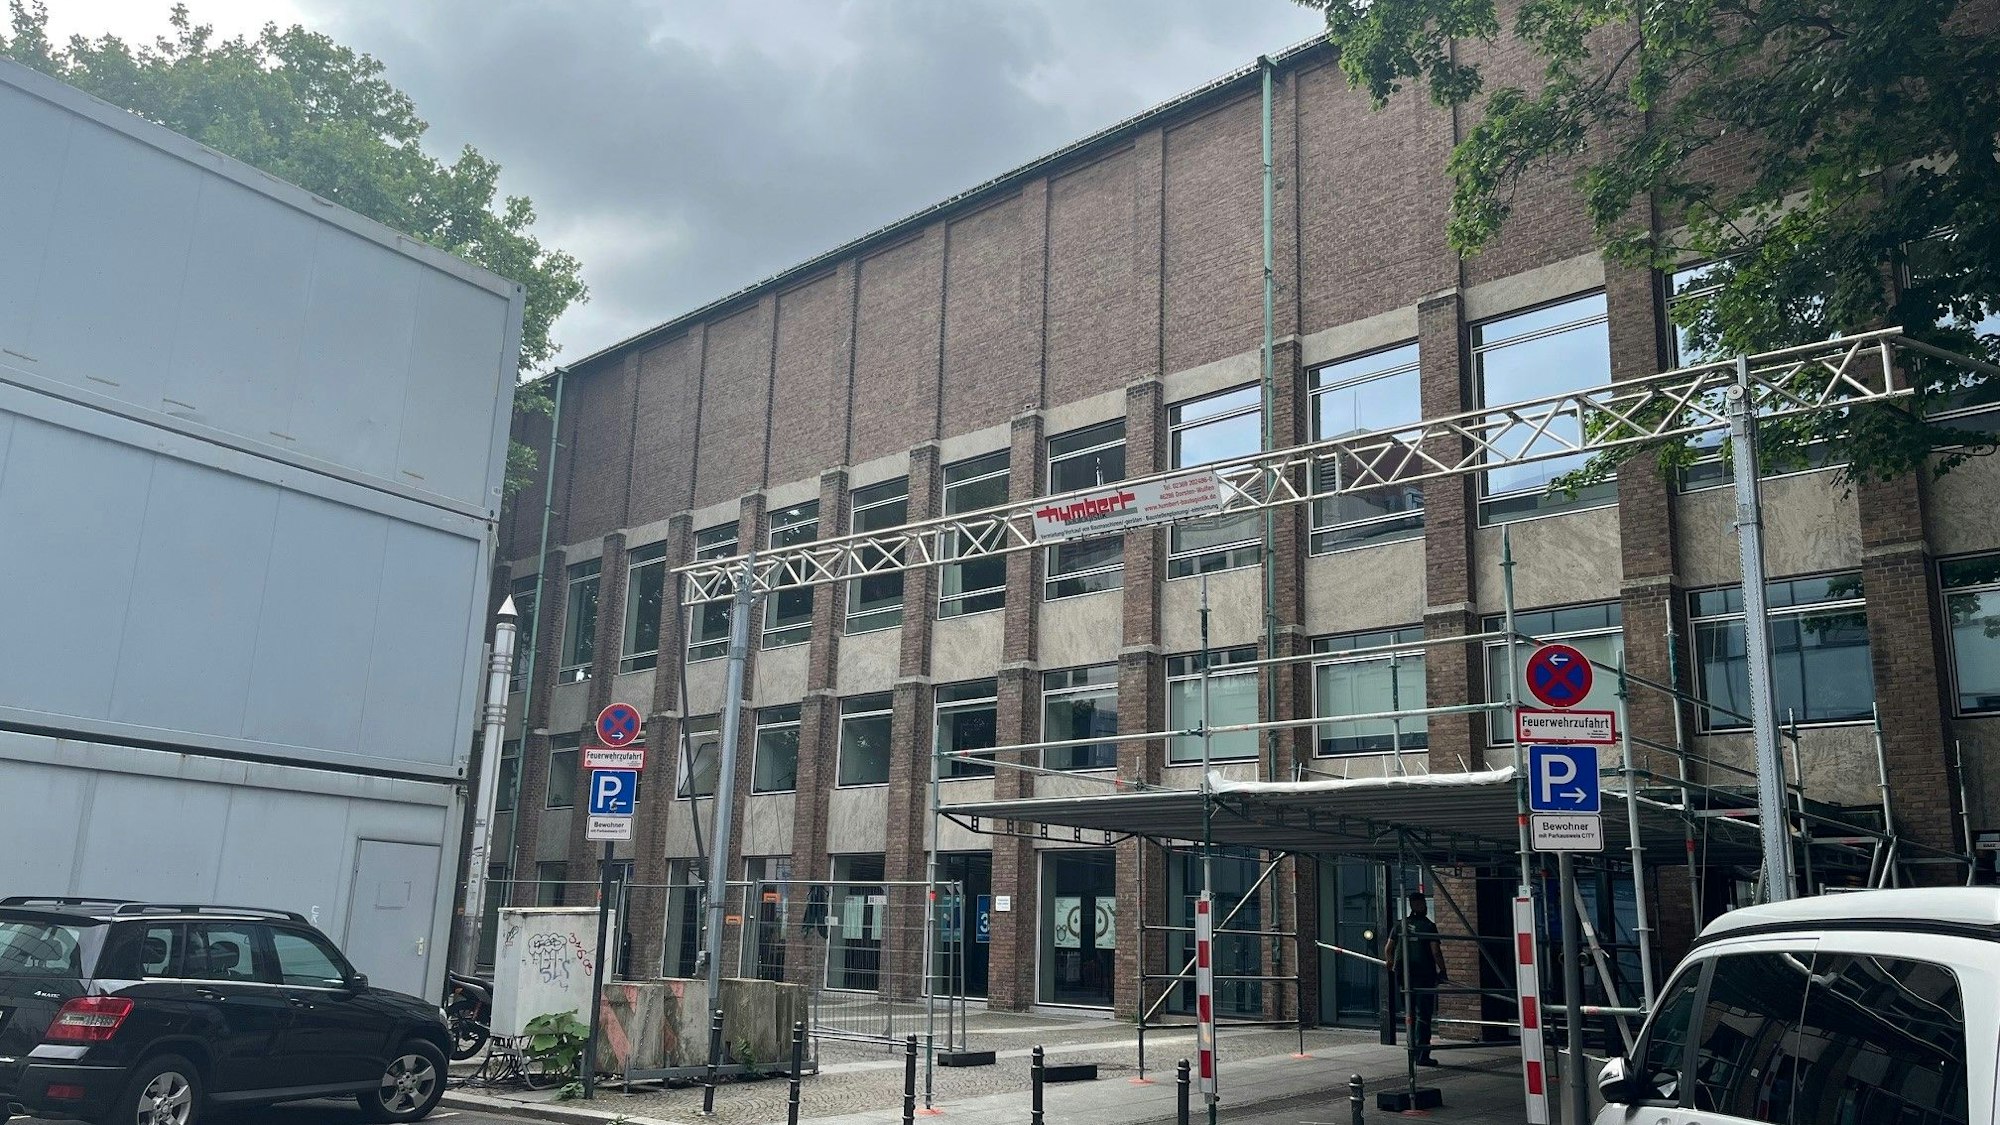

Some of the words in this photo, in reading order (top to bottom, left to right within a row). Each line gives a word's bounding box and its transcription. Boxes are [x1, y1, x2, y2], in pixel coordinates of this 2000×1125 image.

[1037, 491, 1135, 523] humbert
[1522, 715, 1609, 729] Feuerwehrzufahrt
[586, 751, 642, 760] Feuerwehrzufahrt
[1541, 754, 1577, 802] P
[597, 776, 622, 808] P
[1542, 821, 1589, 831] Bewohner
